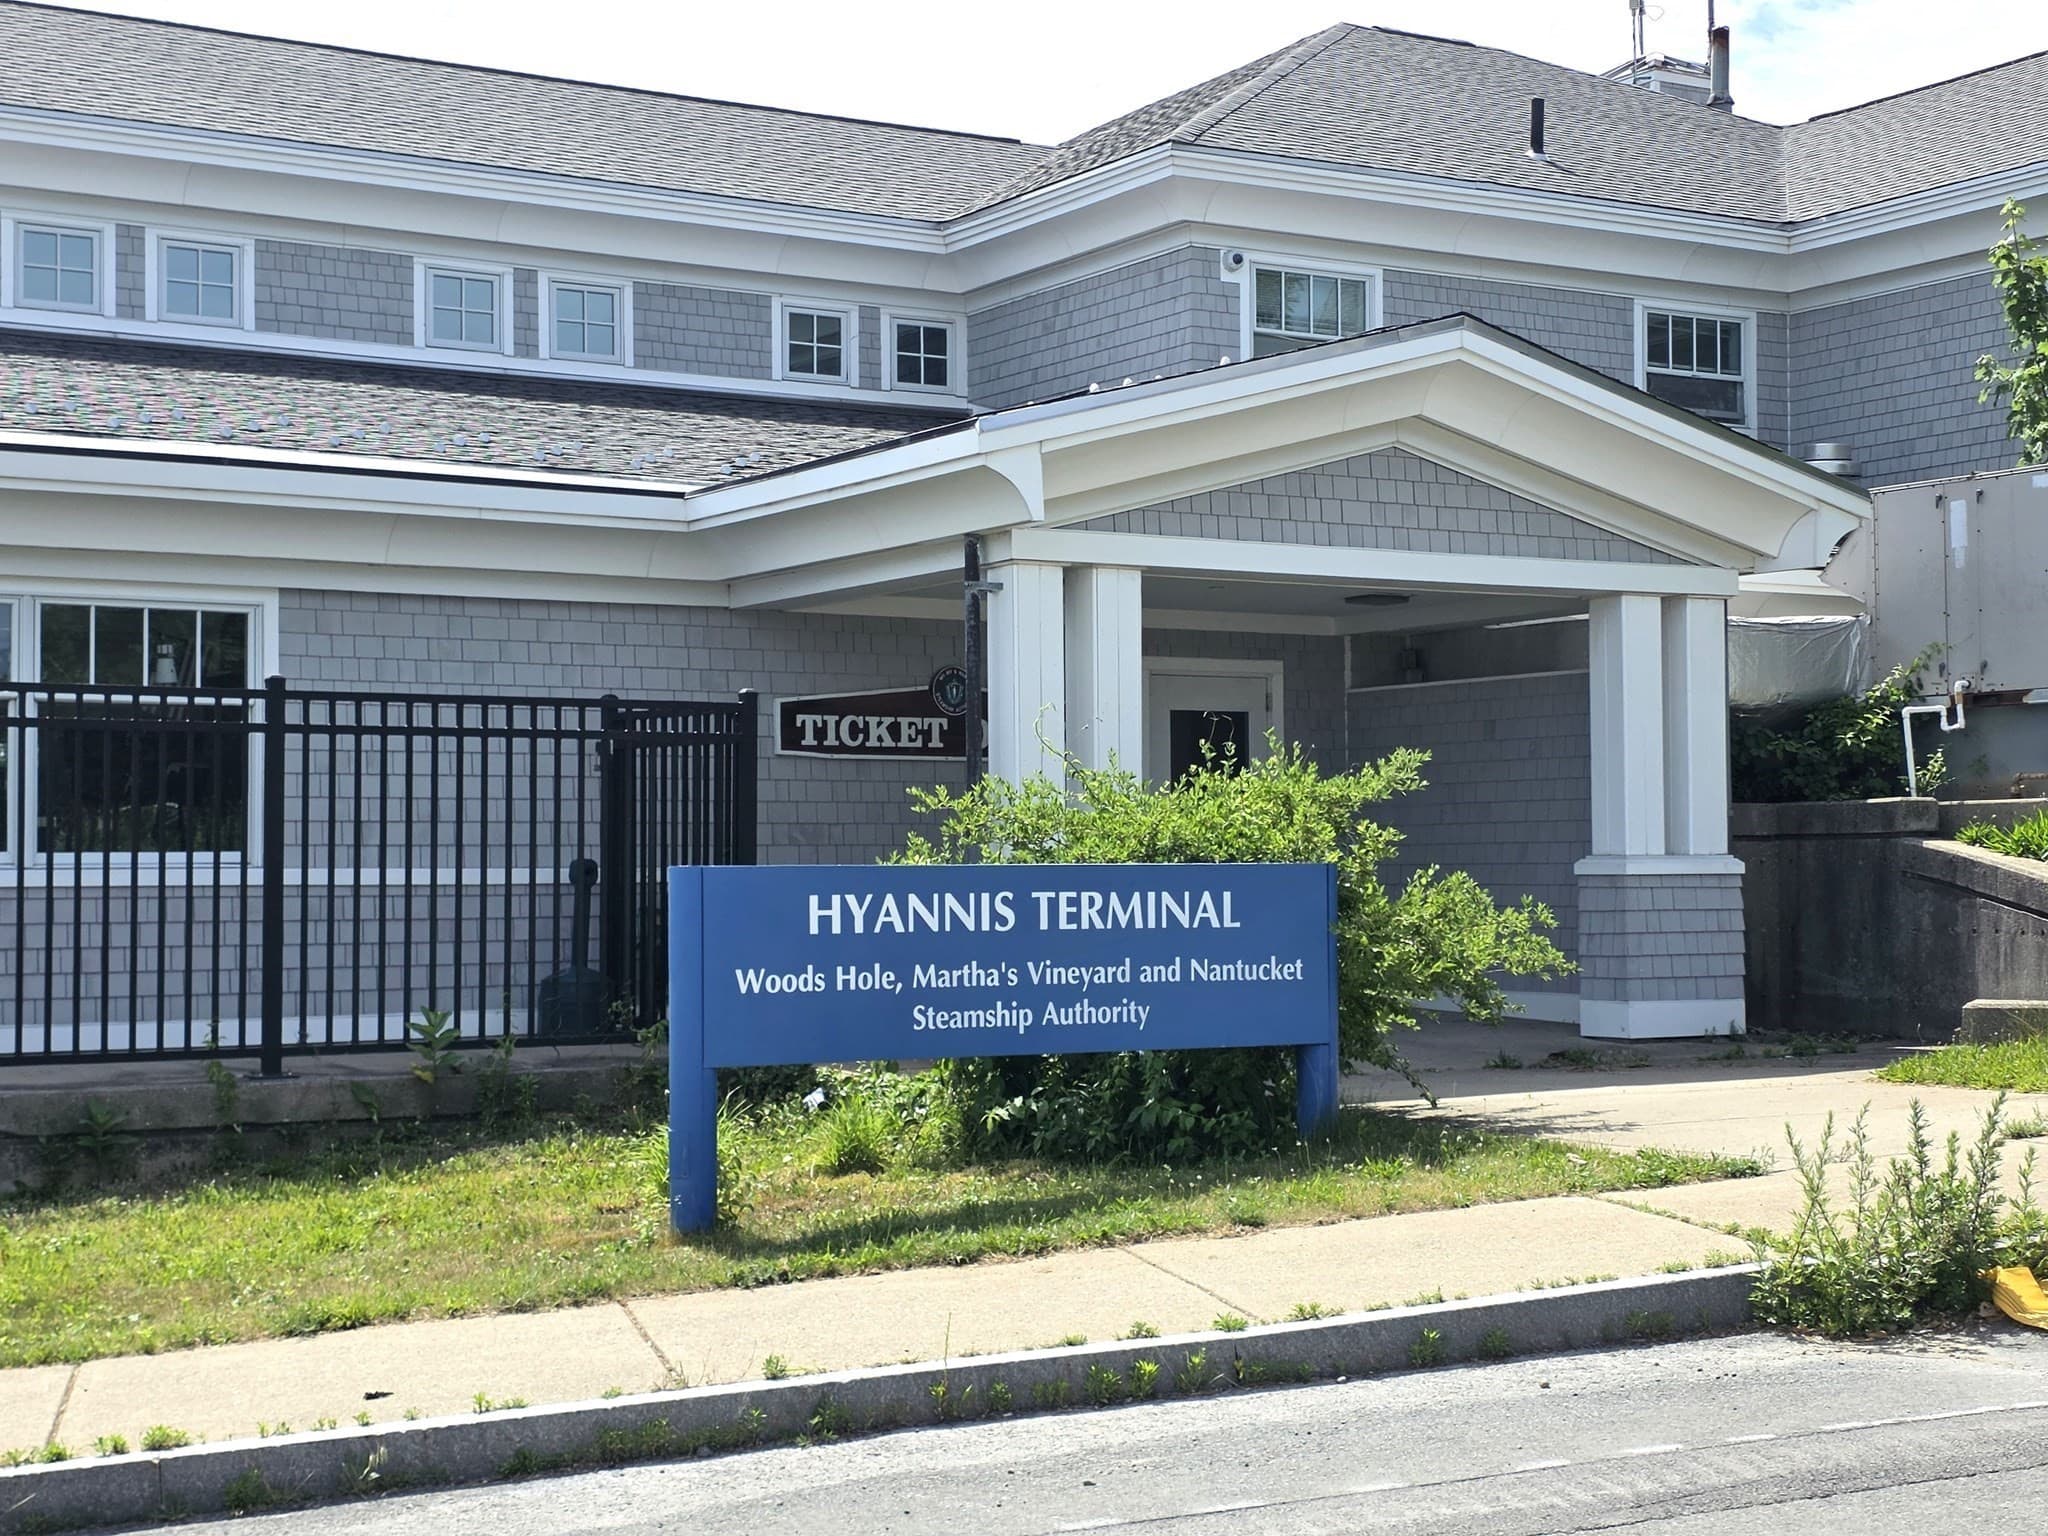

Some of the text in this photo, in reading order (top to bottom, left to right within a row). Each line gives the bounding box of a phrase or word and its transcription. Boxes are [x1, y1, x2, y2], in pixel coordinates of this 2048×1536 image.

[795, 713, 949, 749] TICKET
[808, 890, 1242, 935] HYANNIS TERMINAL
[735, 955, 1304, 995] Woods Hole, Martha's Vineyard and Nantucket
[913, 999, 1150, 1036] Steamship Authority
